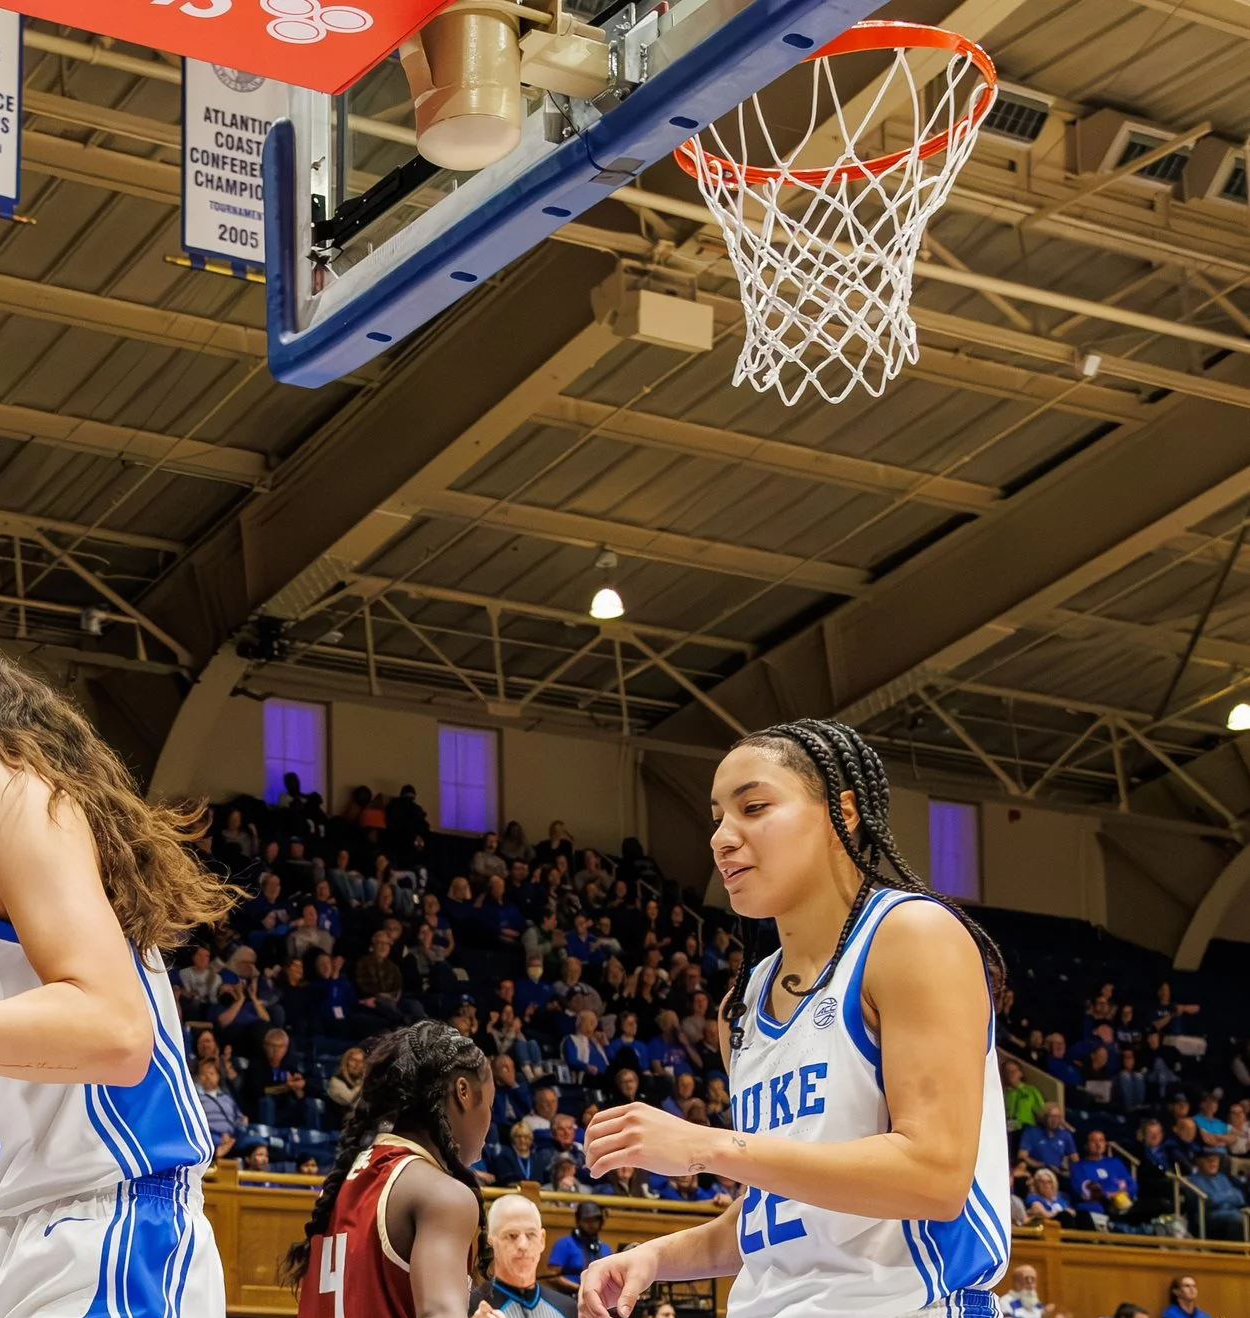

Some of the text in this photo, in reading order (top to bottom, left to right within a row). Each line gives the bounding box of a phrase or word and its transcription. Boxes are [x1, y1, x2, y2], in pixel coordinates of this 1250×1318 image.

[214, 131, 263, 157] COAST
[190, 147, 264, 179] CONFERE
[218, 224, 259, 248] 2005
